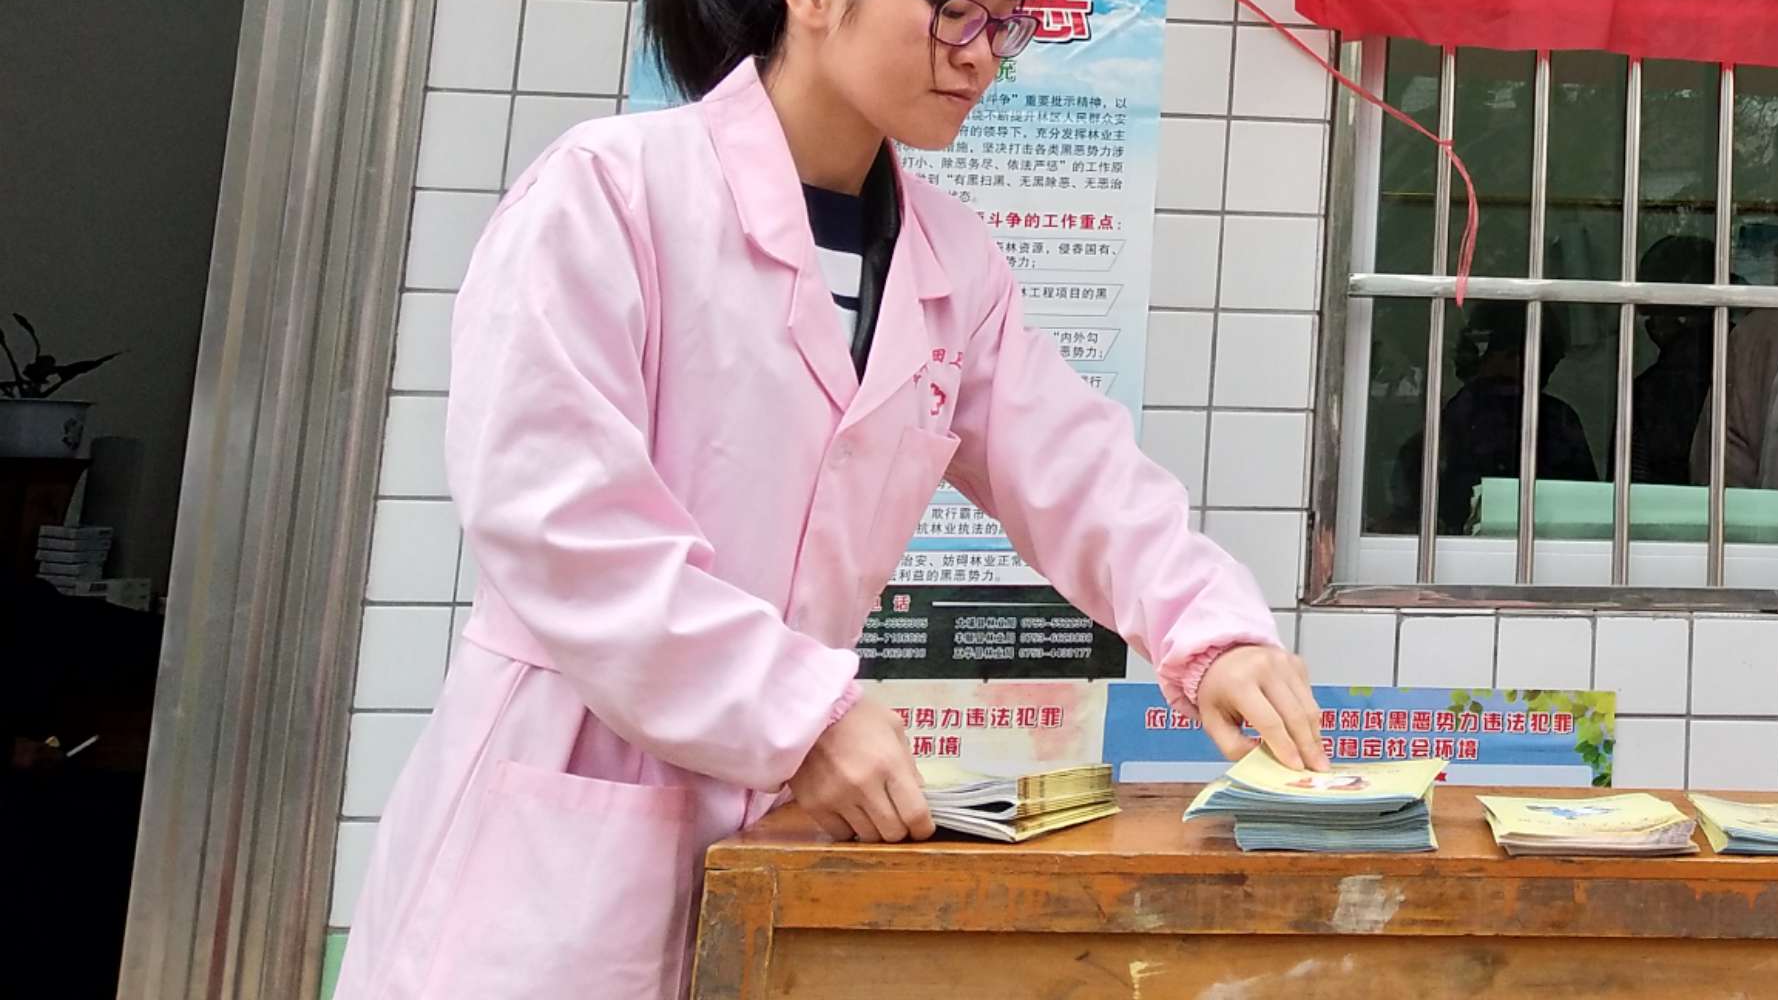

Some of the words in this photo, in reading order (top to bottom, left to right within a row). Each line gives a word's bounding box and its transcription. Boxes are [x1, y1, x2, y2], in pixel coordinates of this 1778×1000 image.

[966, 109, 1126, 126] 绕不断提升林区人民群众安
[977, 211, 1123, 231] 斗争的工作重点：
[1022, 287, 1107, 300] 工程项目的黑
[917, 523, 1005, 535] 抗林业执法的
[901, 554, 1030, 567] 治安、妨碍林业正常
[888, 569, 1001, 582] 利益的黑恶势力。
[912, 736, 961, 758] 环境
